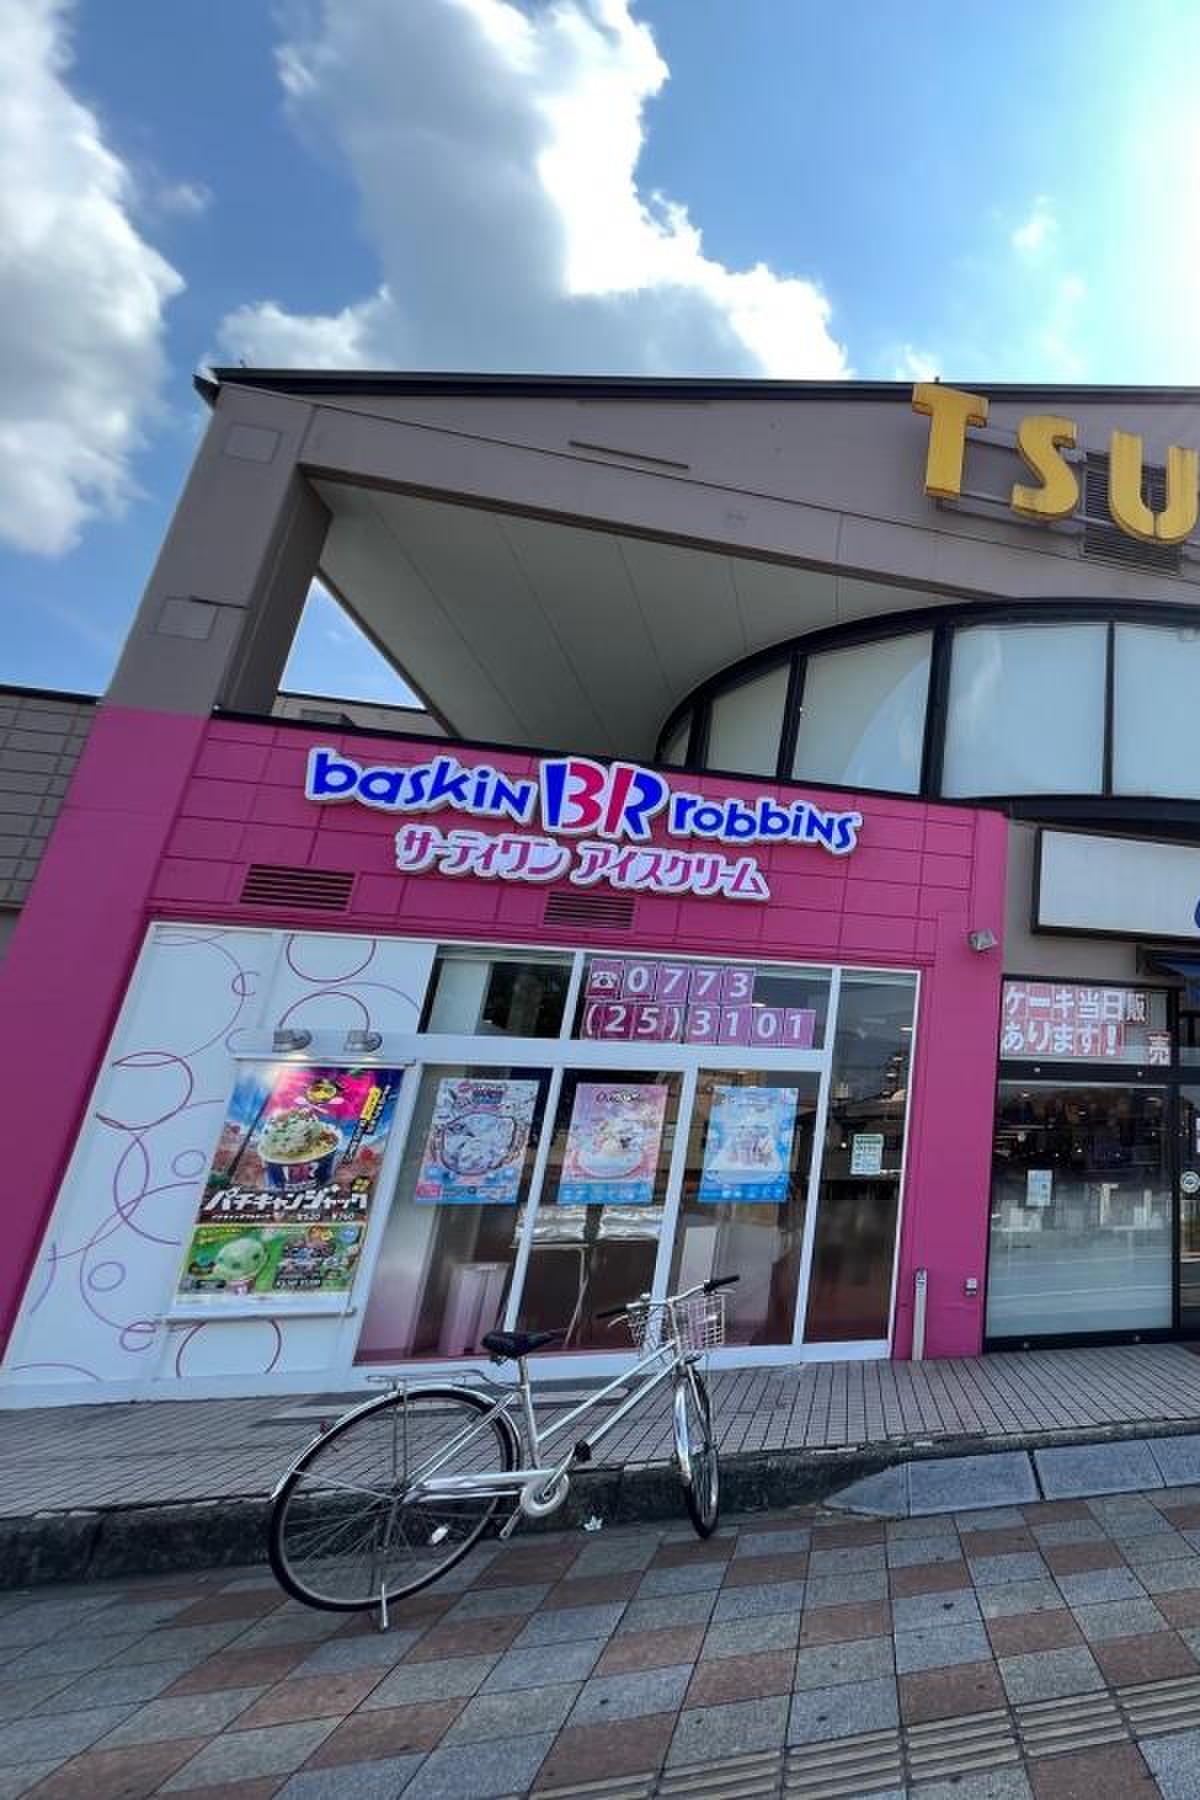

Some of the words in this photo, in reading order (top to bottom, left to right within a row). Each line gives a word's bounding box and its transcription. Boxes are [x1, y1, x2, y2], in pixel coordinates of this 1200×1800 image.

[308, 750, 536, 824] baskin
[543, 760, 666, 837] BR
[671, 795, 862, 852] robbins
[401, 828, 564, 874] サーティワン
[578, 846, 767, 898] アイスクリーム
[626, 966, 749, 998] 0773
[585, 1003, 802, 1039] (25)3101
